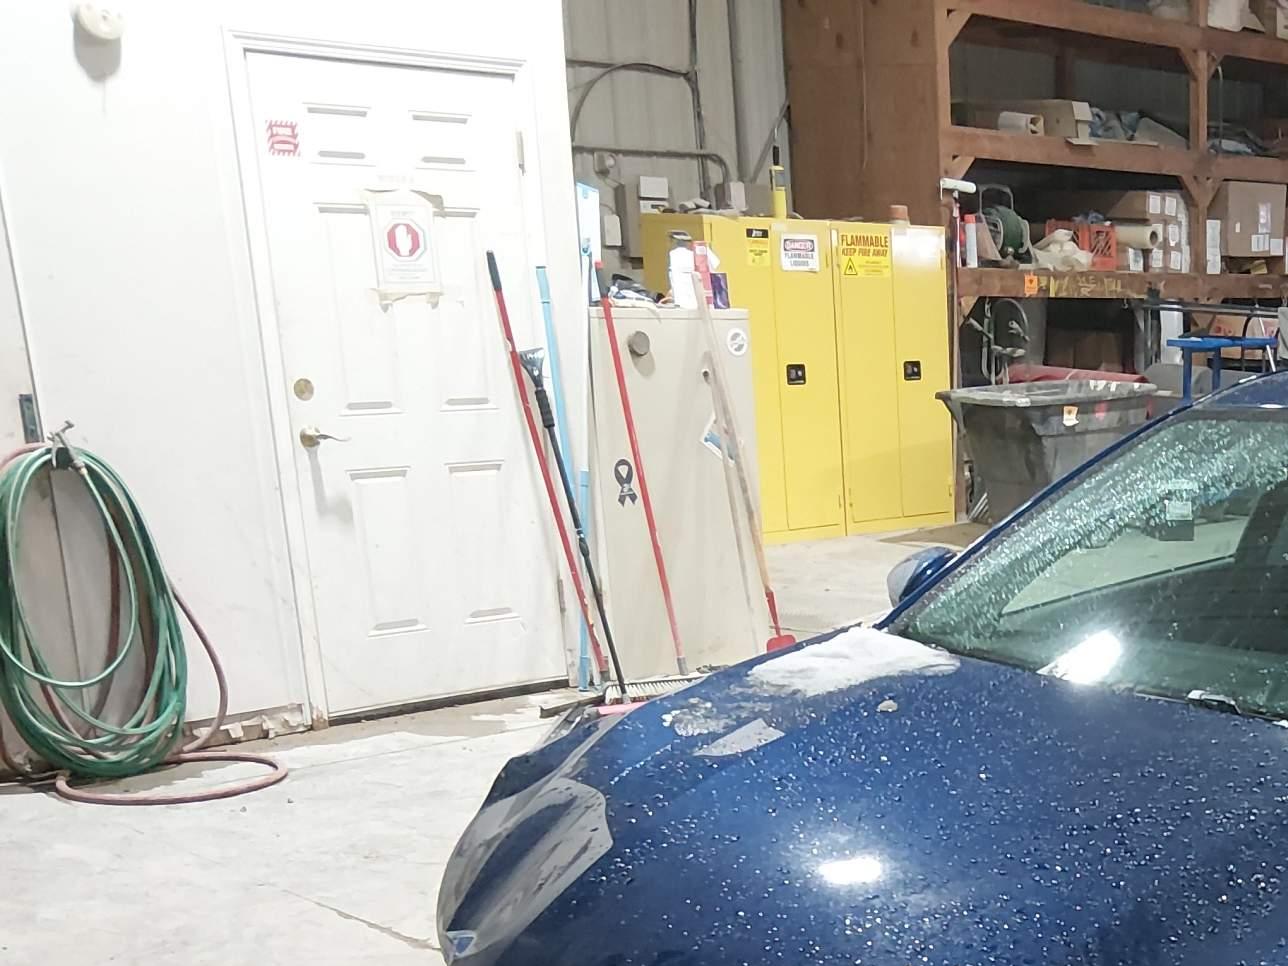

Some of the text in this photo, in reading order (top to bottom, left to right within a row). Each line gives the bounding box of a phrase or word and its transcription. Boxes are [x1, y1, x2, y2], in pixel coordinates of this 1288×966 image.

[786, 240, 814, 251] DANGER
[841, 234, 889, 247] FLAMMABLE
[842, 248, 857, 256] KEEP
